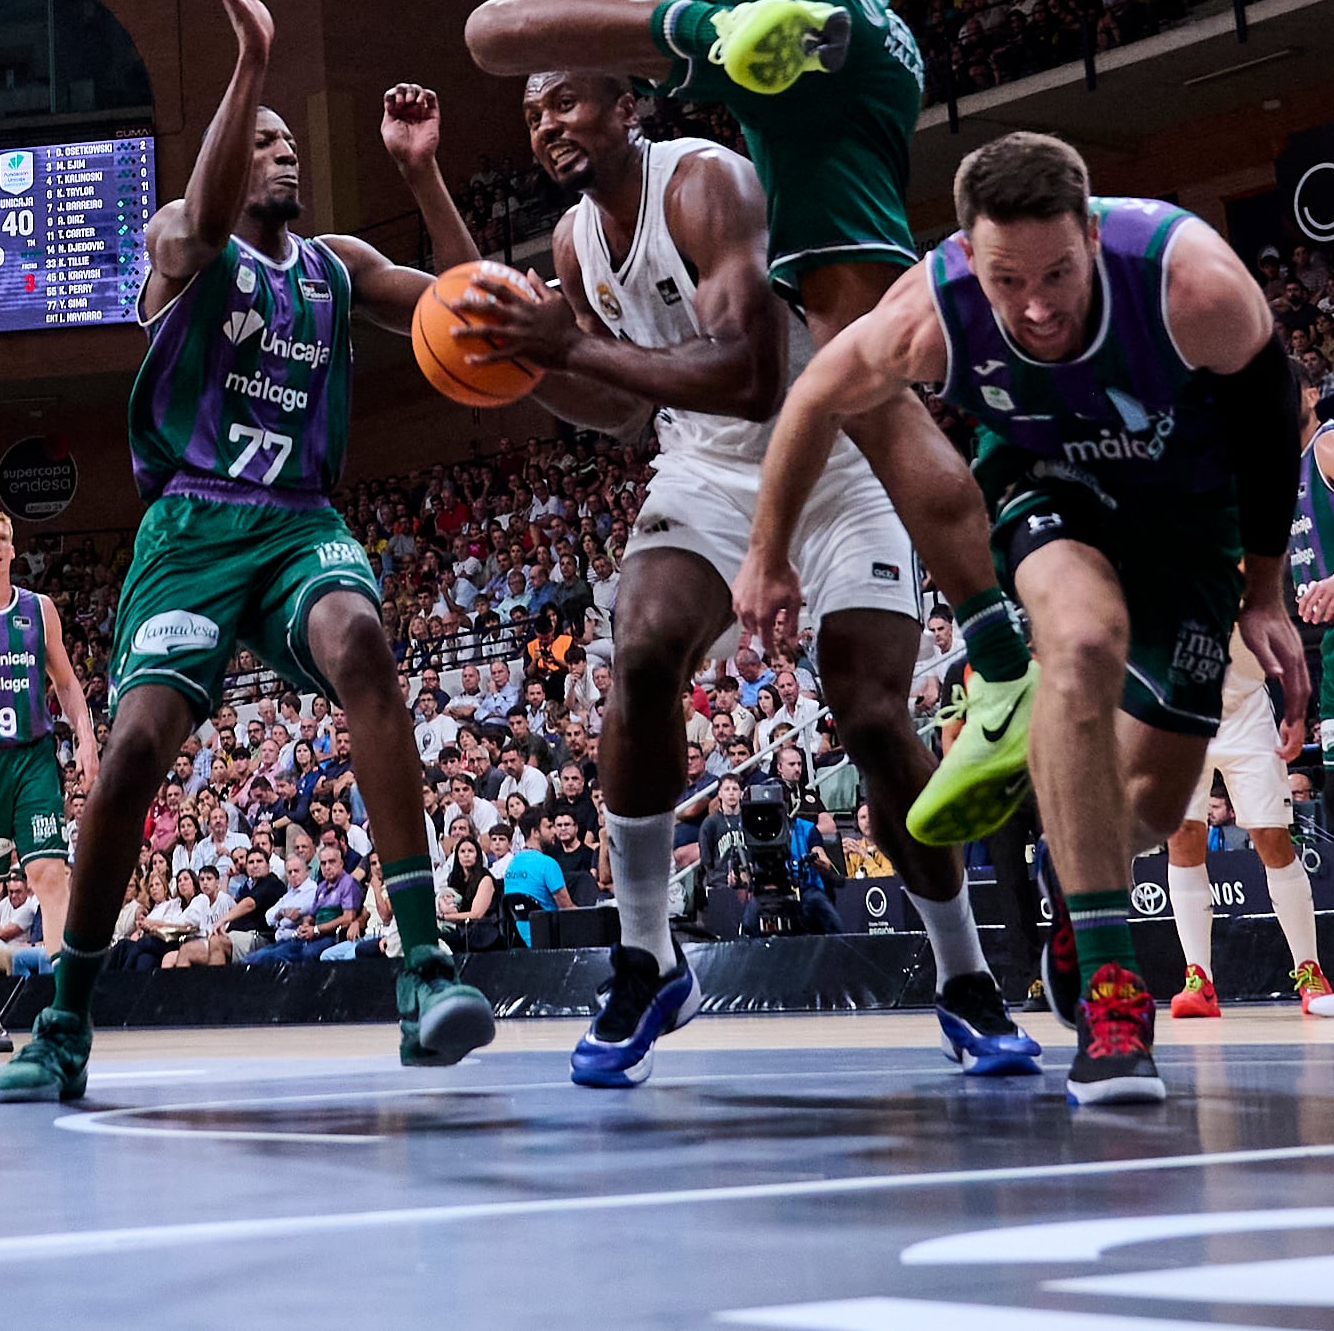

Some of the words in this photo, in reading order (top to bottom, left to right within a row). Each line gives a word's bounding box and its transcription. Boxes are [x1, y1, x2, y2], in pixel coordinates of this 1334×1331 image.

[65, 144, 113, 156] OSETKOWSKI
[67, 159, 85, 170] EJIM
[65, 172, 102, 184] KALINOSKI
[66, 186, 94, 197] TAYLOR
[0, 197, 33, 209] UNICAJA
[2, 210, 33, 236] 40
[67, 214, 84, 224] DIAZ
[66, 227, 95, 239] CARTER
[67, 241, 104, 253] DJEDOVIC
[67, 256, 89, 267] TILLIE
[24, 273, 35, 293] 3
[68, 283, 93, 294] PERRY
[68, 298, 87, 308] SIMA
[260, 328, 330, 369] Unicaja
[228, 422, 293, 485] 77
[3, 465, 71, 480] supercopa
[9, 477, 71, 494] endesa
